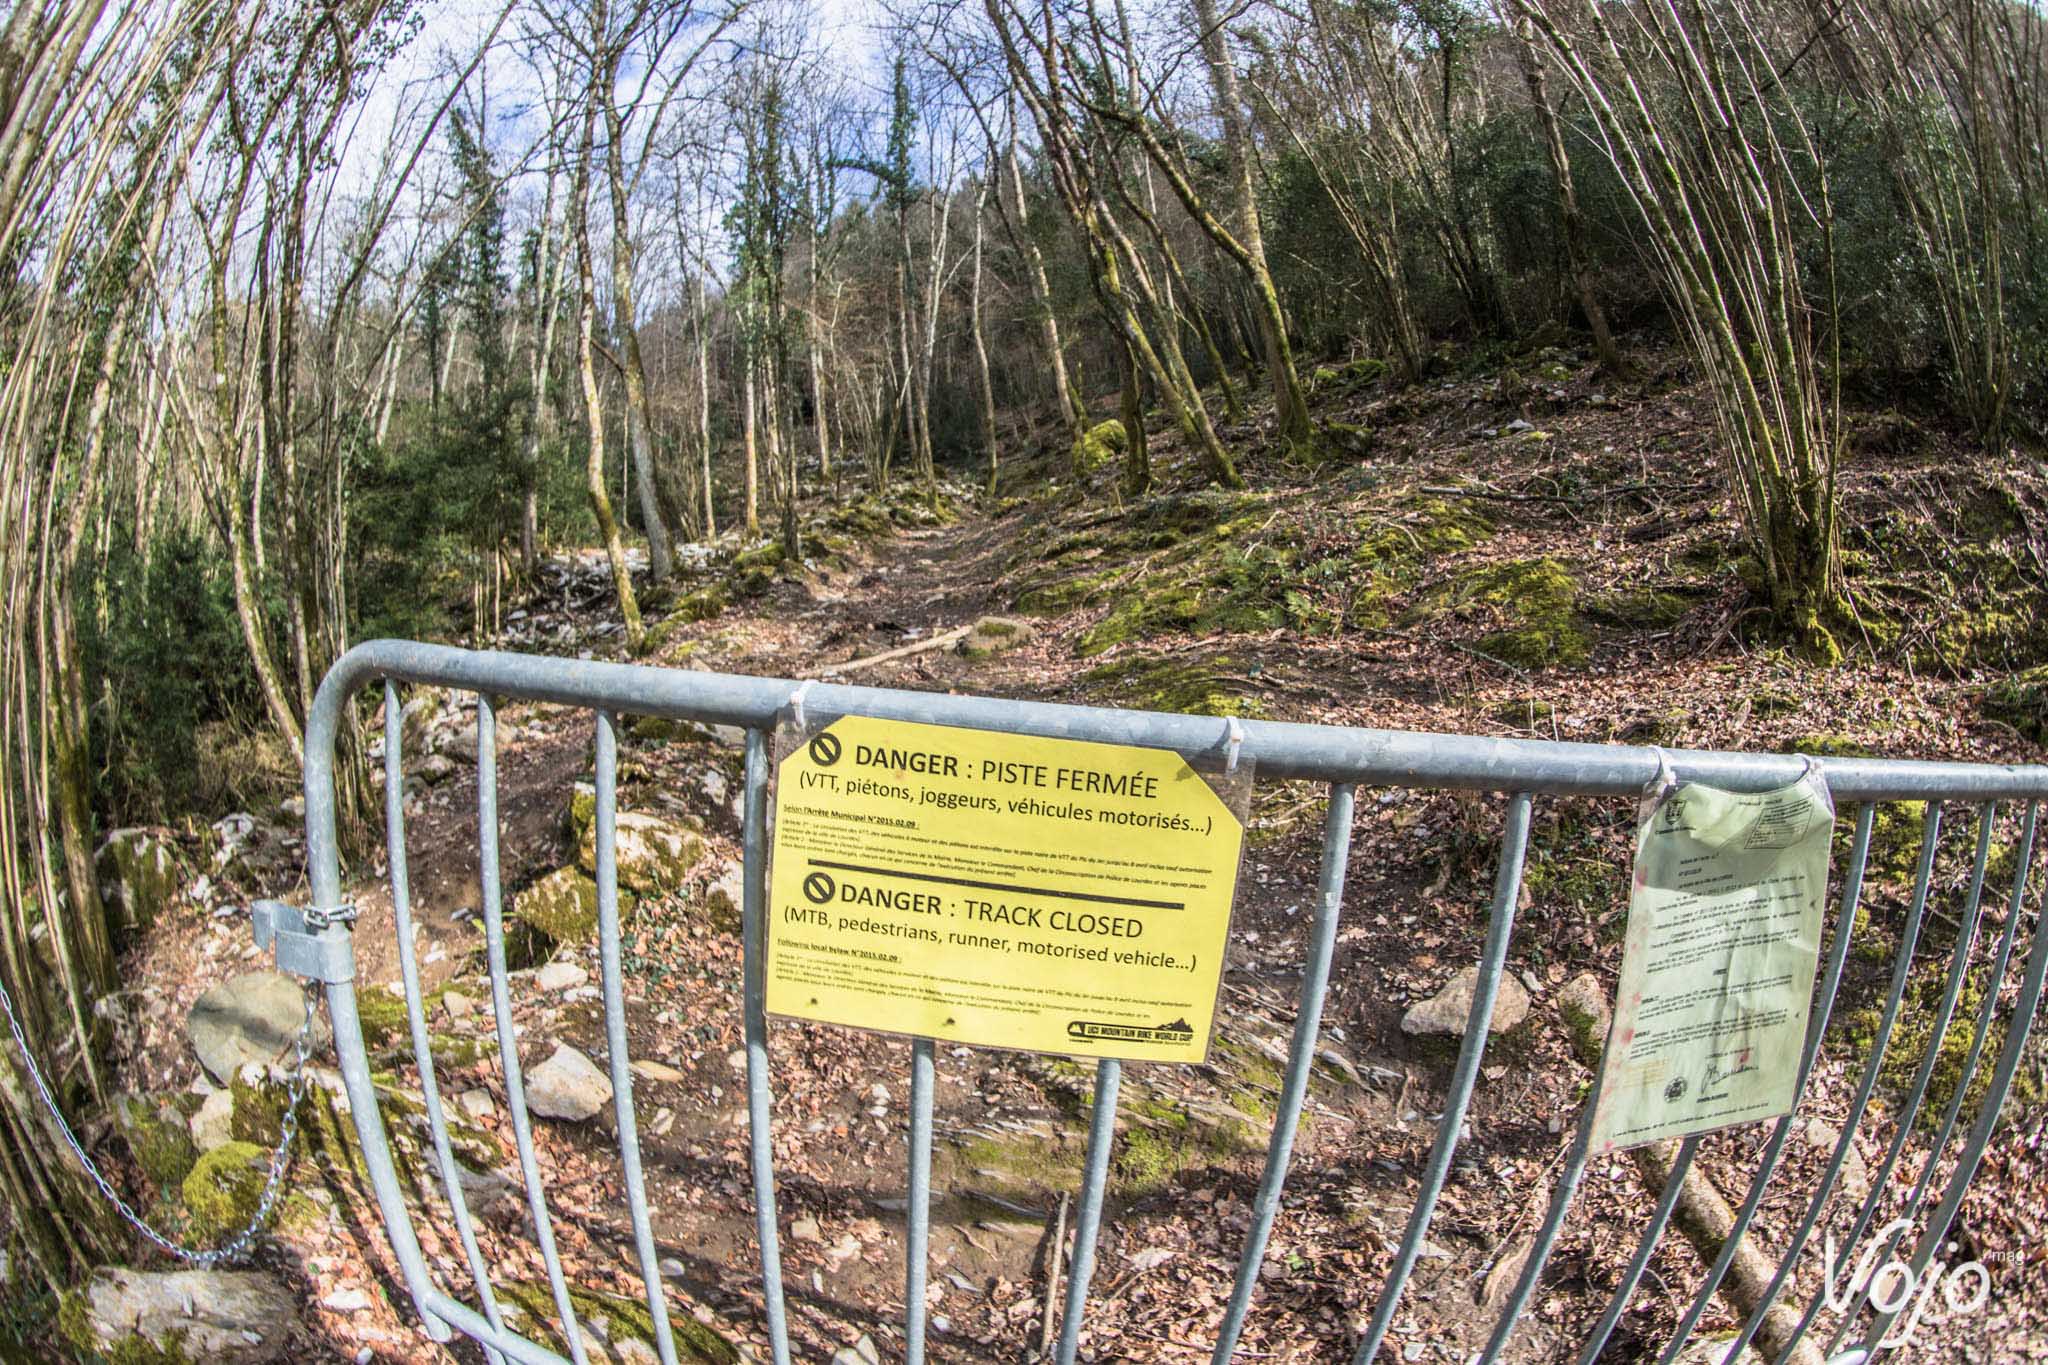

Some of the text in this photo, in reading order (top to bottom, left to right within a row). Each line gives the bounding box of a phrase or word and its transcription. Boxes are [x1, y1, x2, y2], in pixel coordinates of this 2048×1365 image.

[856, 745, 958, 777] DANGER
[982, 760, 1048, 787] PISTE
[1056, 768, 1159, 798] FERMÉE
[800, 770, 1213, 836] (VTT, piétons, joggeurs, véhicules motorisés...)
[830, 810, 866, 823] Municipal
[841, 884, 942, 915] DANGER
[964, 900, 1043, 928] TRACK
[1049, 911, 1143, 938] CLOSED
[784, 905, 1197, 973] (MTB, pedestrians, runner, motorised vehicle...)
[1101, 1027, 1136, 1038] MOUNTAIN
[1137, 1029, 1152, 1039] BIKE
[1154, 1031, 1178, 1041] WORLD
[1179, 1033, 1193, 1042] CUP
